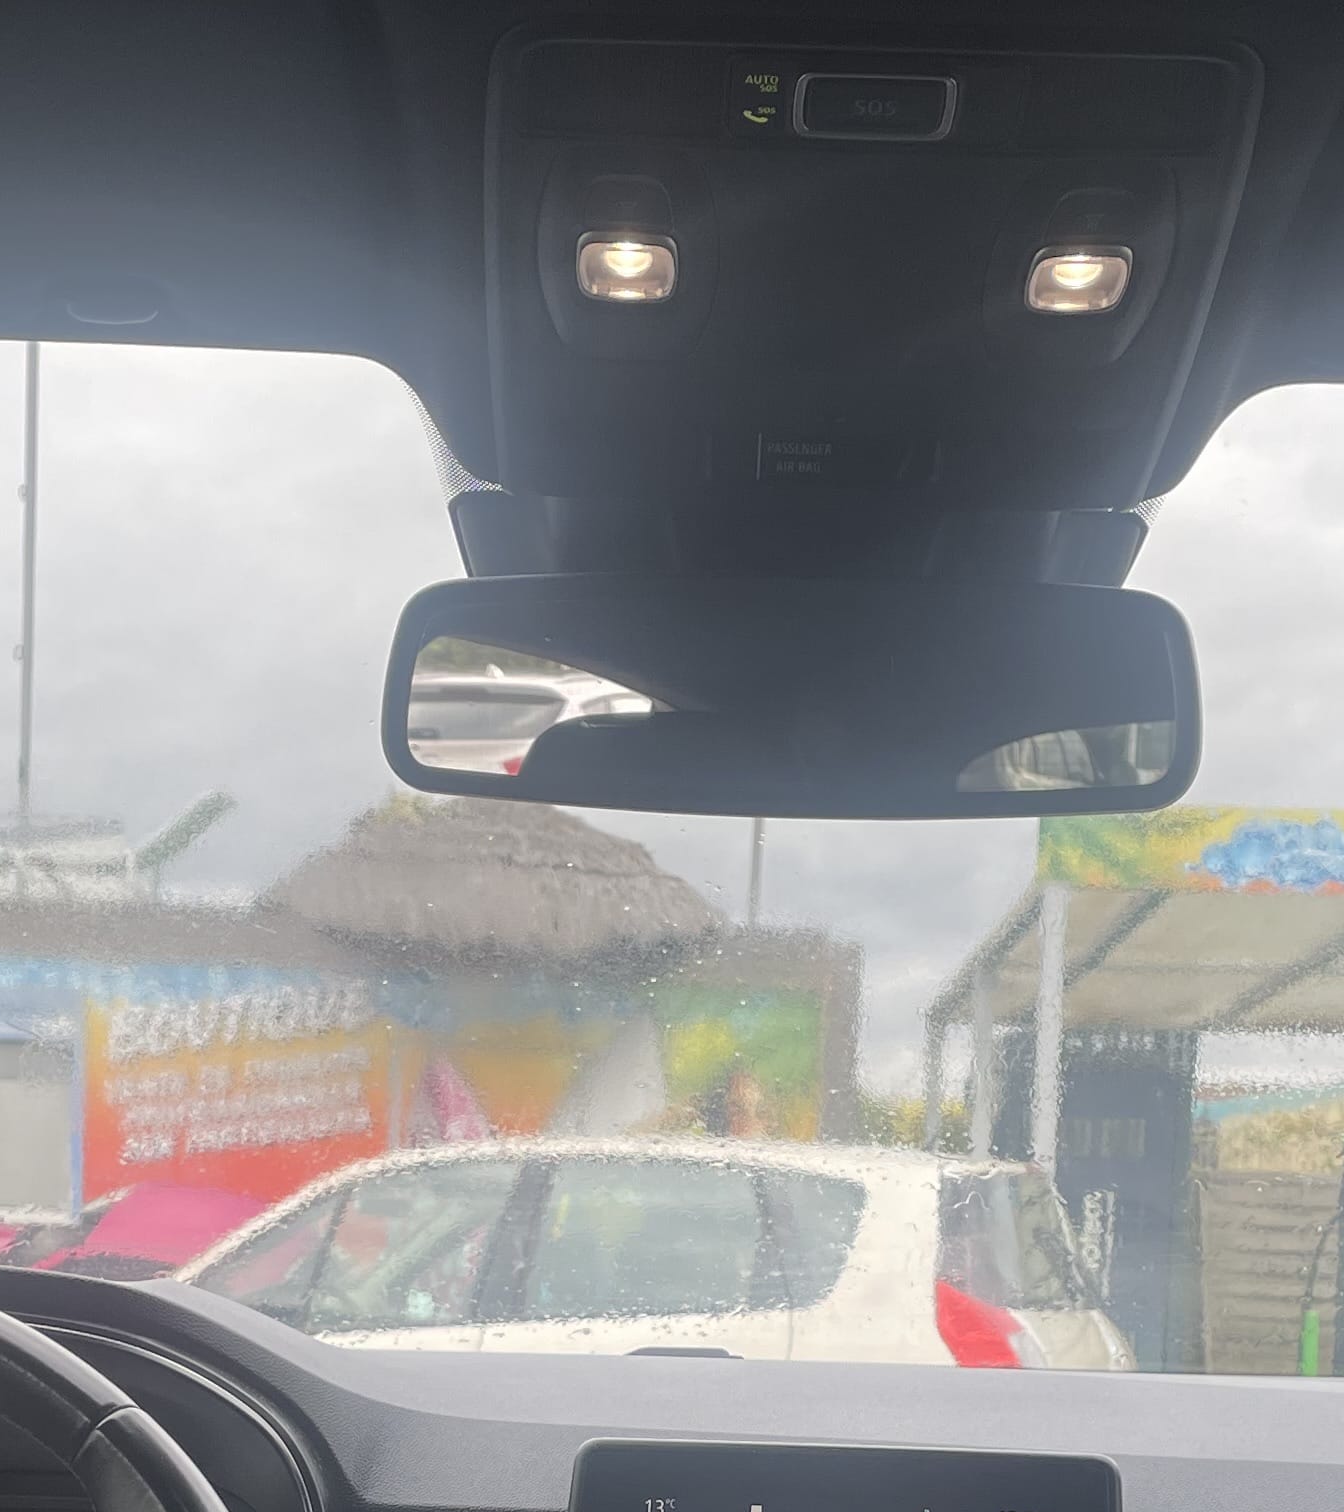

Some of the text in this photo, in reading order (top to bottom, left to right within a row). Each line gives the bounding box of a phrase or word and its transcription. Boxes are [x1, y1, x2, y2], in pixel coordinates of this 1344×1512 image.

[744, 74, 779, 86] AUTO
[759, 84, 778, 93] SOS
[855, 100, 896, 116] SOS
